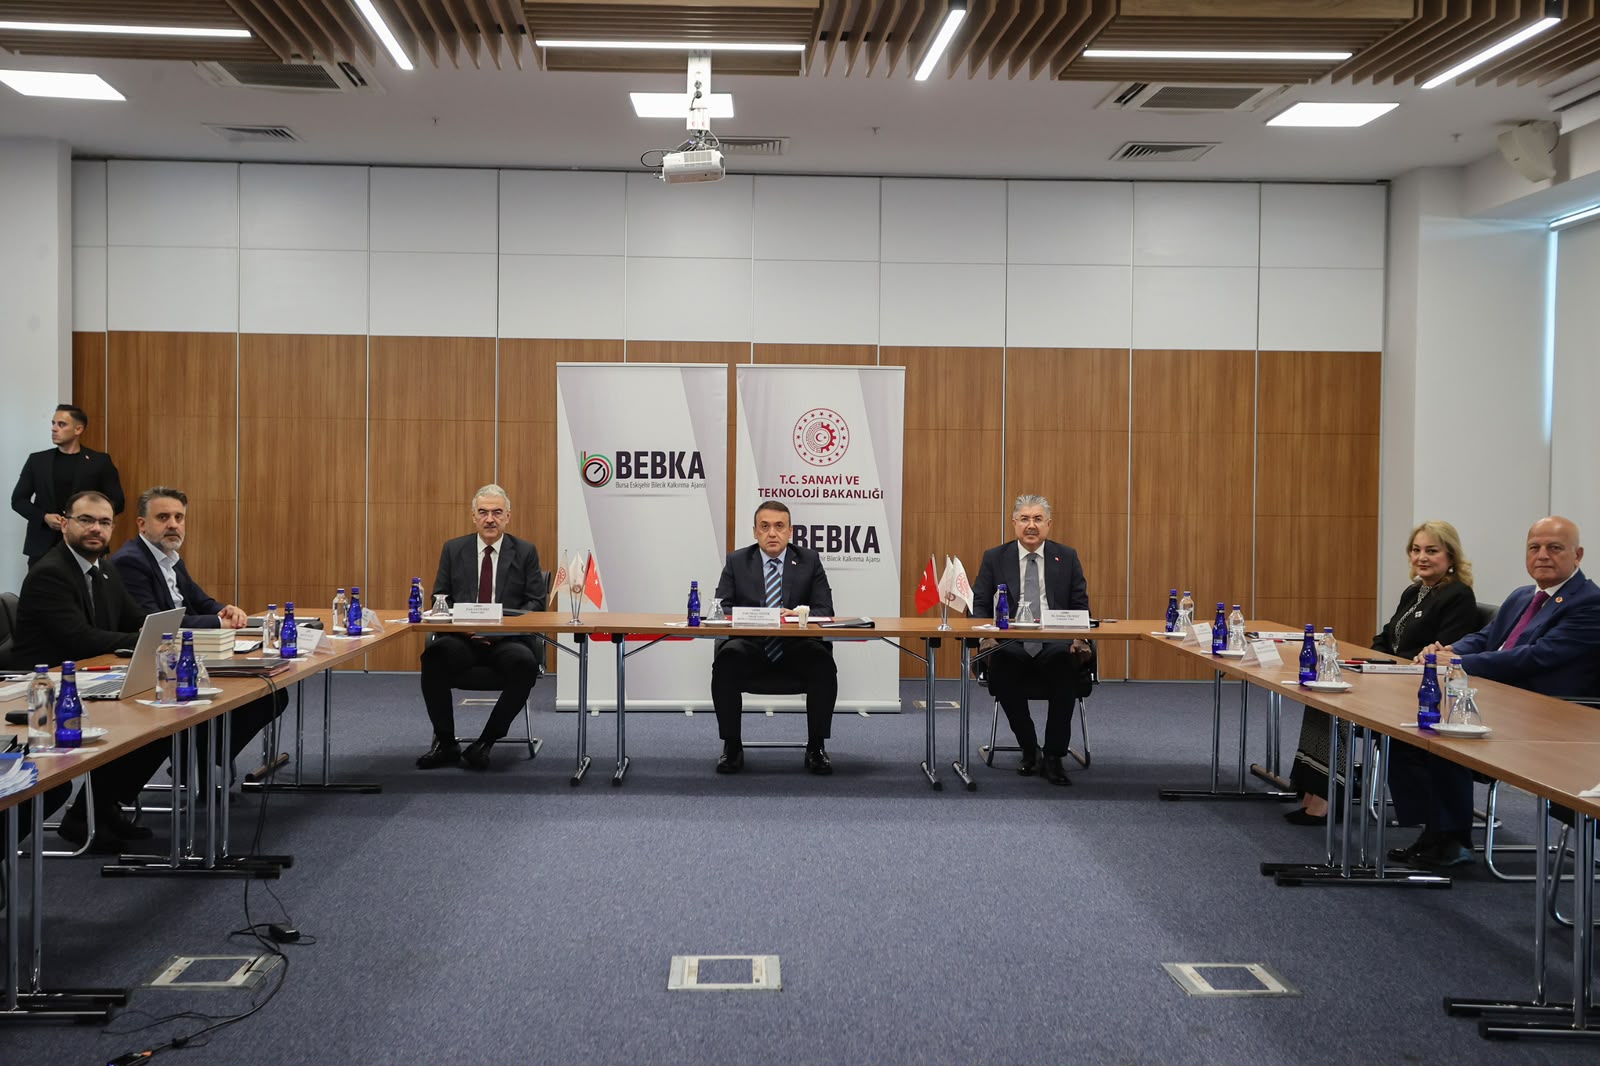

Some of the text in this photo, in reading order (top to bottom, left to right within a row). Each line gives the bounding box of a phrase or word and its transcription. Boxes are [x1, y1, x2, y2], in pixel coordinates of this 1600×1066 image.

[616, 451, 705, 479] BEBKA
[615, 481, 629, 489] Bursa
[630, 481, 650, 490] Eskişehir
[780, 474, 860, 485] T.C. SANAYİ VE
[758, 487, 884, 499] TEKNOLOJİ BAKANLIĞI
[793, 525, 880, 553] BEBKA
